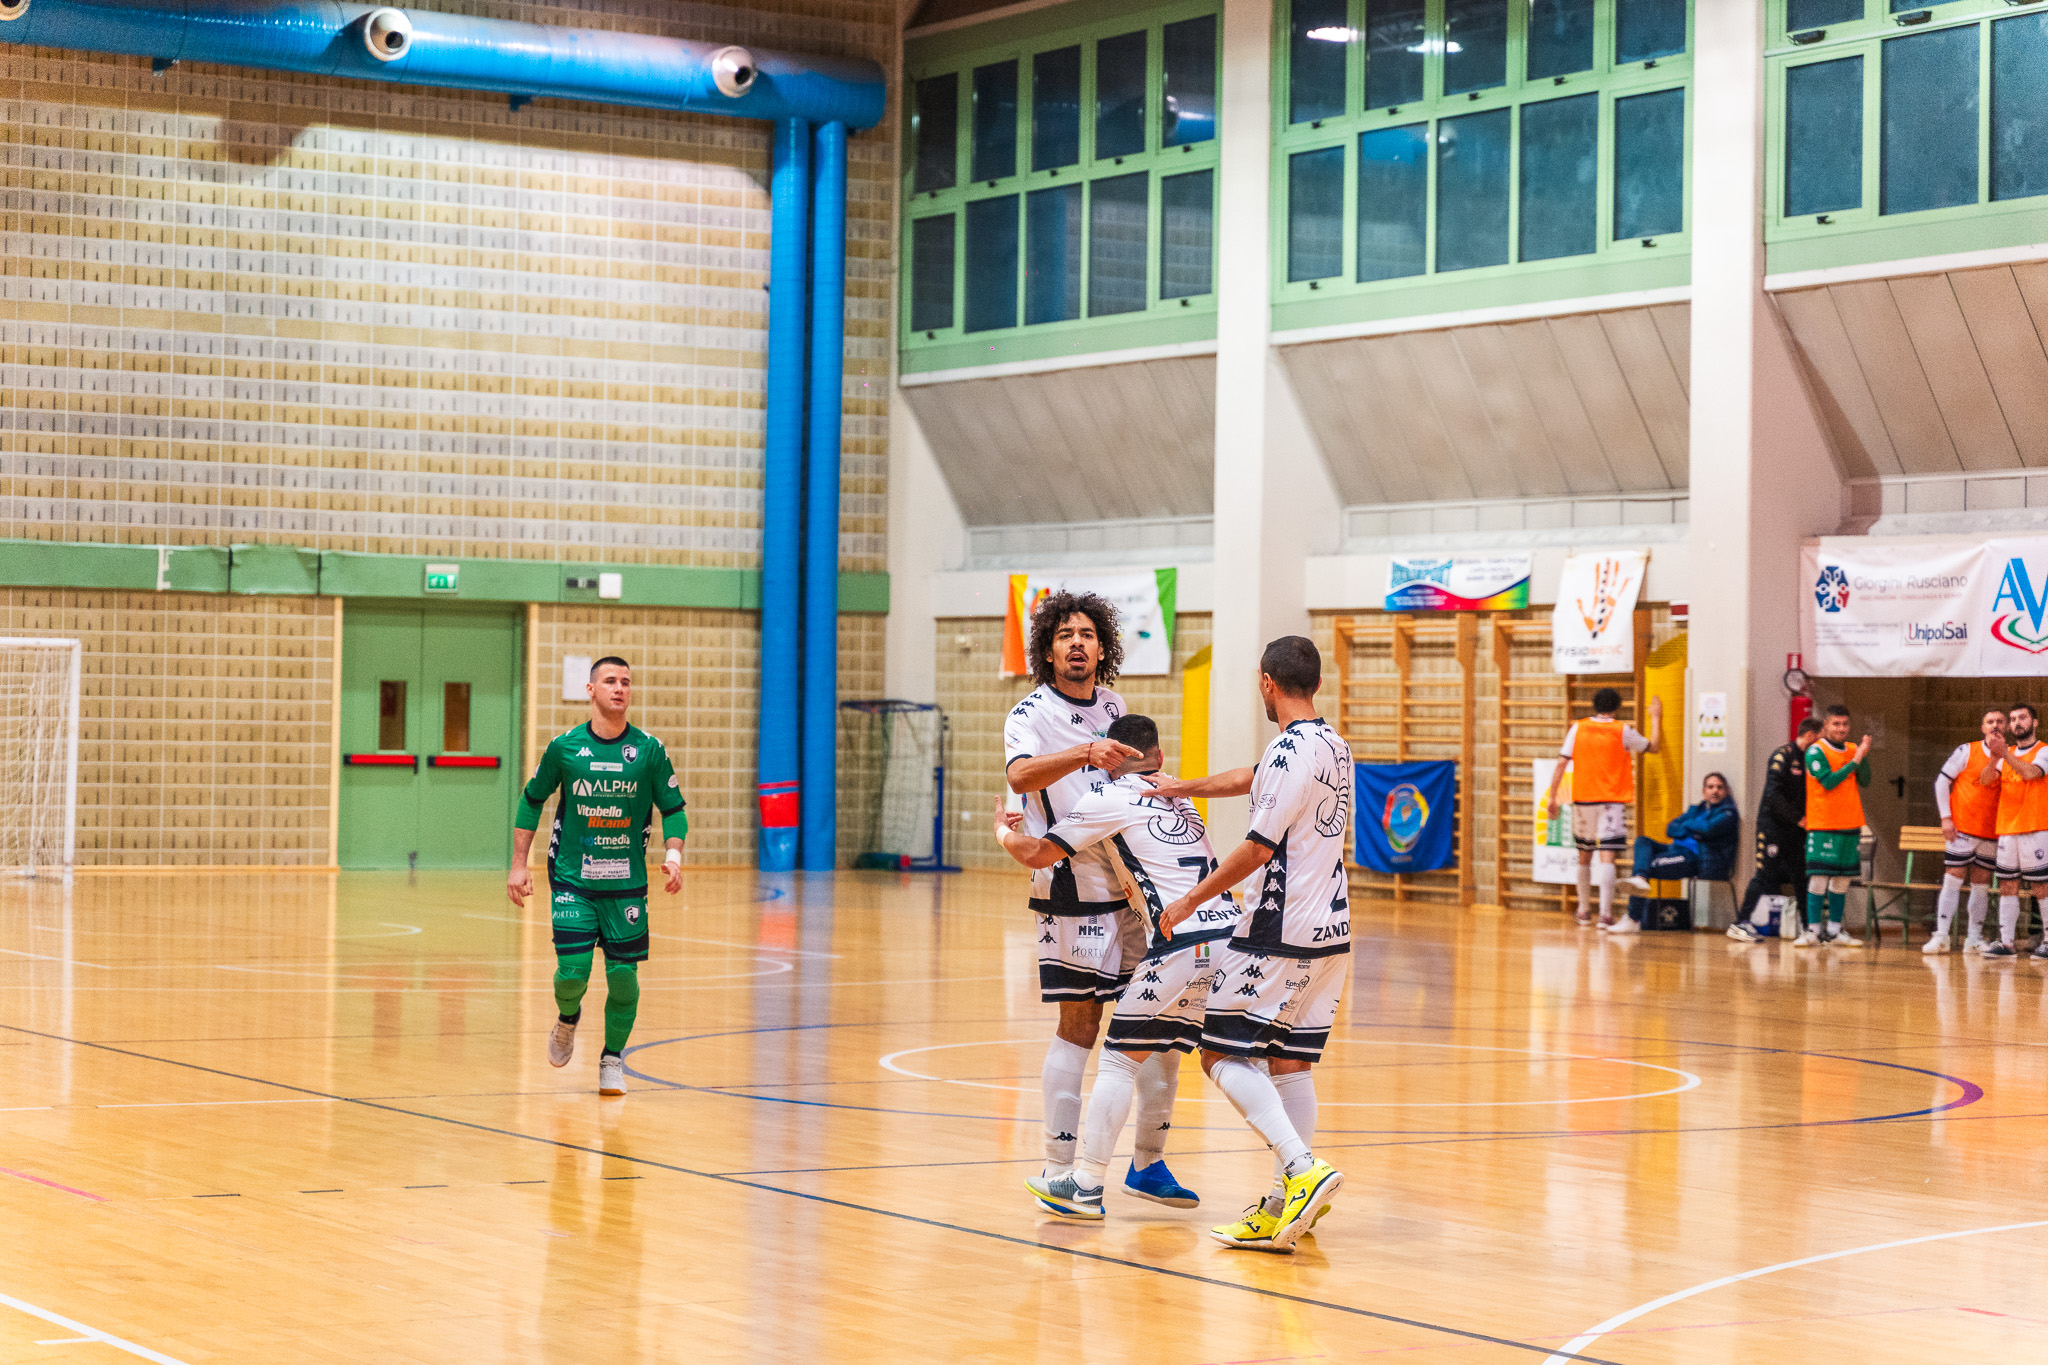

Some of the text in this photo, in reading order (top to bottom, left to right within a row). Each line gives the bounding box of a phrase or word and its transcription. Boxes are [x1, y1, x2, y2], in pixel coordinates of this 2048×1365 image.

[1907, 575, 1968, 589] Rusciano
[1908, 621, 1968, 645] UnipolSai
[593, 779, 637, 793] ALPHA
[577, 804, 622, 817] Vitobello
[588, 816, 632, 828] Ricambi
[1079, 925, 1104, 936] NMC
[1312, 919, 1351, 942] ZAND
[1072, 945, 1104, 957] HORTU
